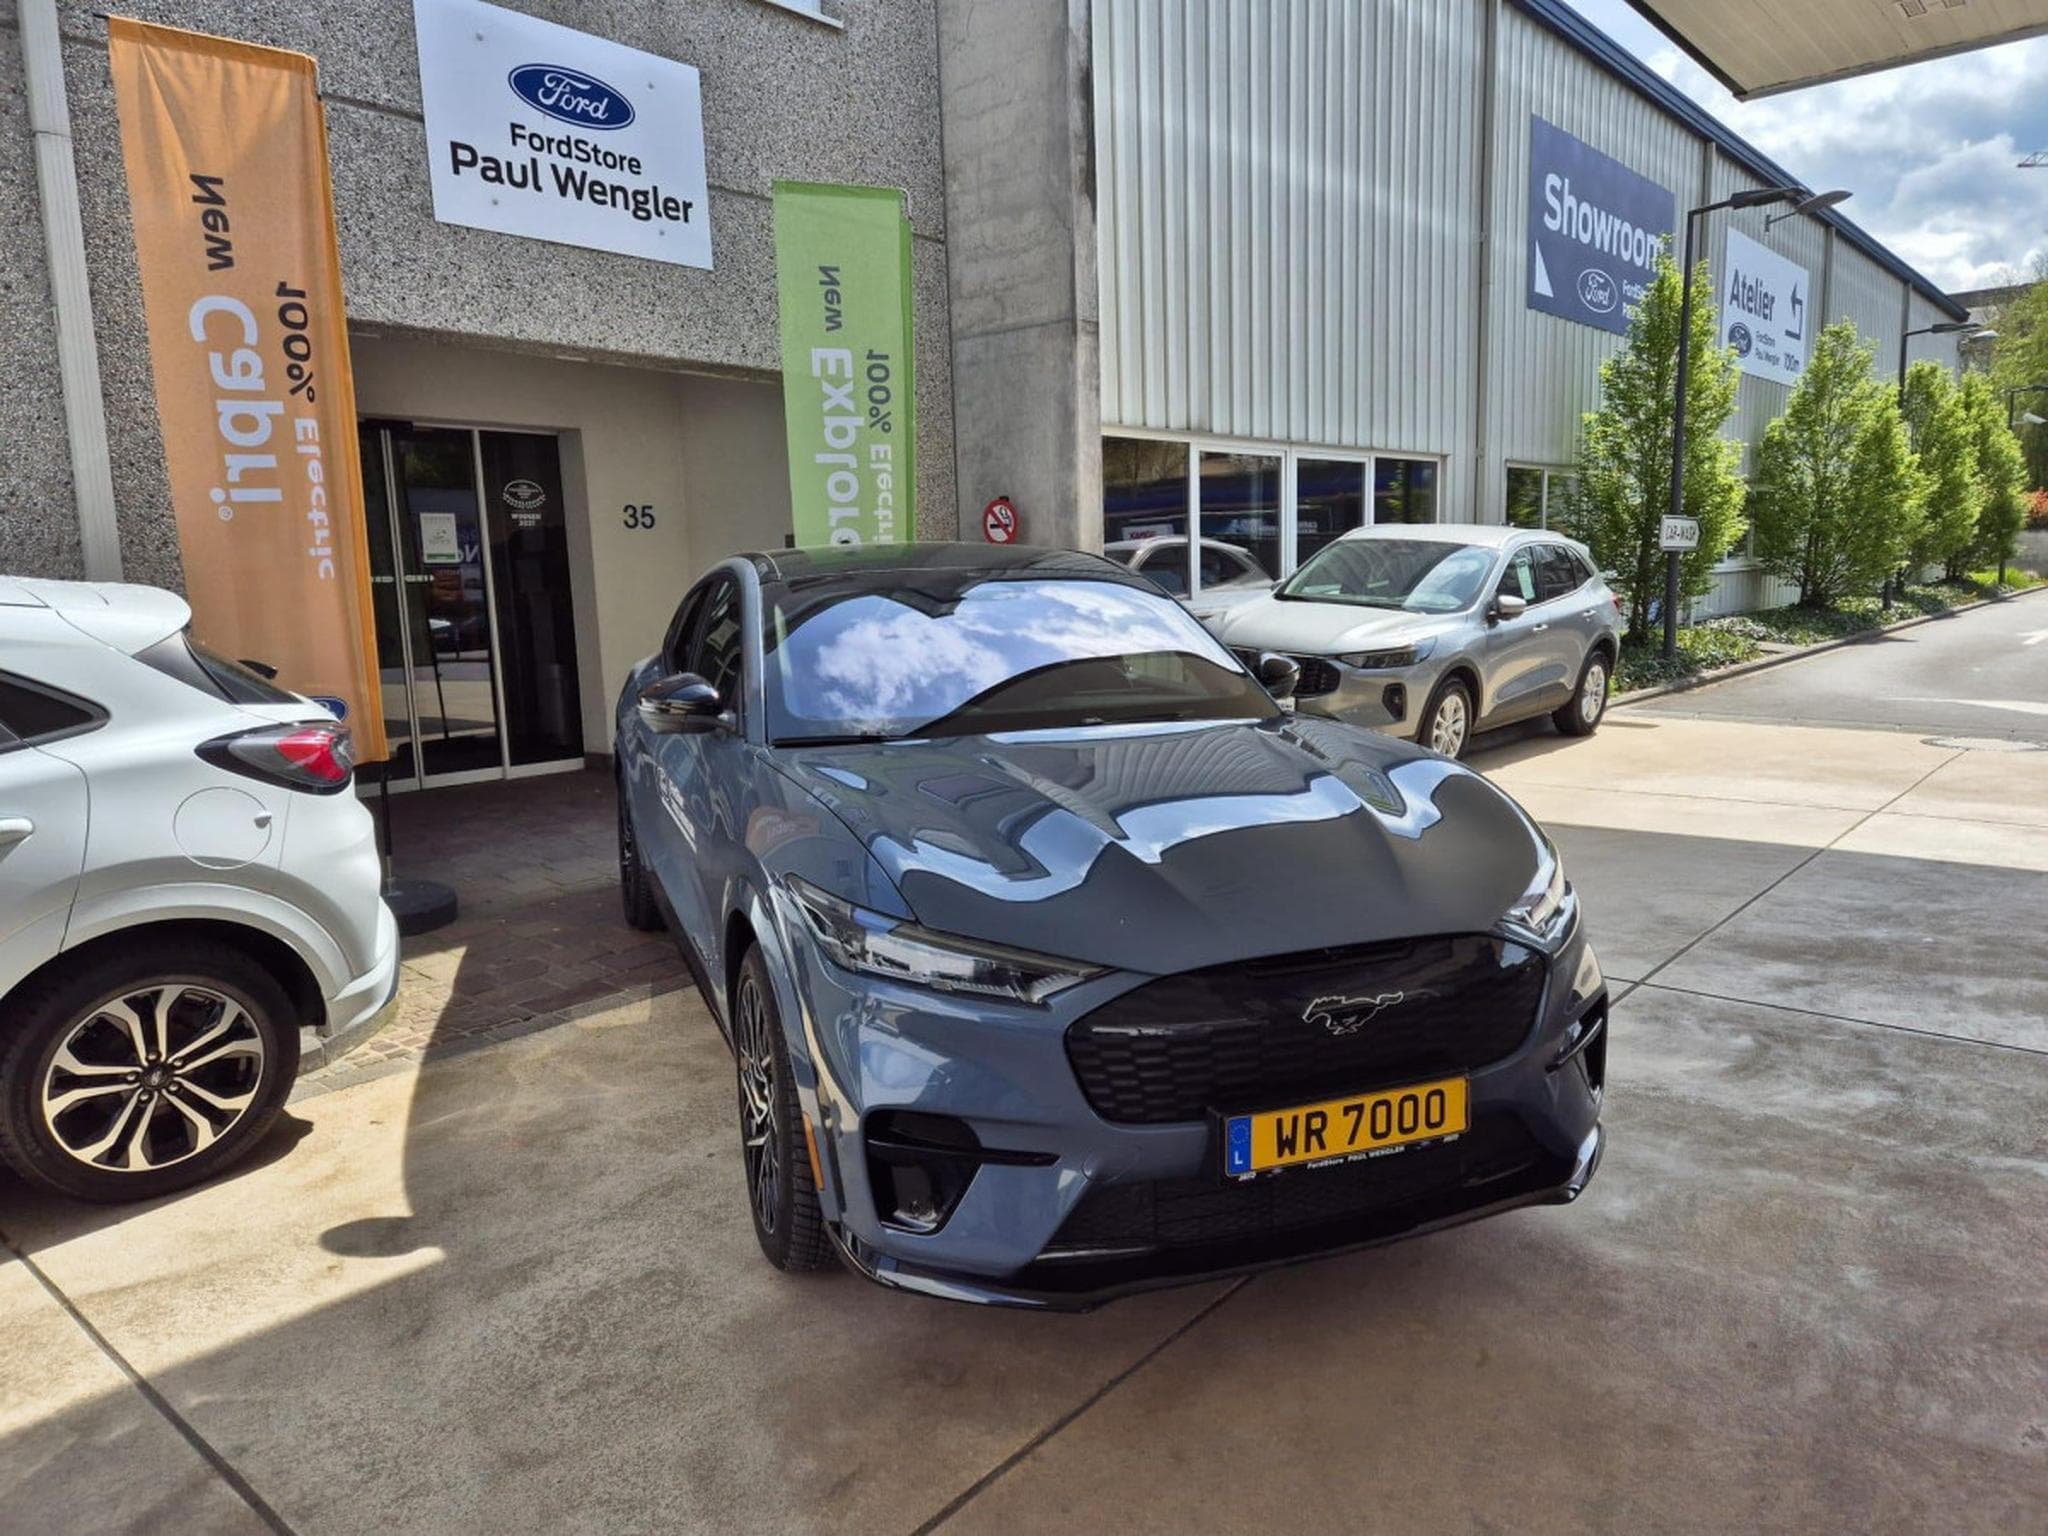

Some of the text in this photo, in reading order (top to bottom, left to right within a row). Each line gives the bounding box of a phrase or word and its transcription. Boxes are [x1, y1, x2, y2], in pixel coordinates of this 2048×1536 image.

[538, 73, 609, 120] Ford
[510, 122, 642, 175] FordStore
[450, 141, 693, 223] Paul Wengler
[1544, 173, 1663, 272] Showroom
[1585, 273, 1611, 305] Ford
[1729, 268, 1775, 322] Atelier
[623, 504, 655, 530] 35
[1276, 1088, 1445, 1158] WR 7000
[1233, 1151, 1244, 1166] L
